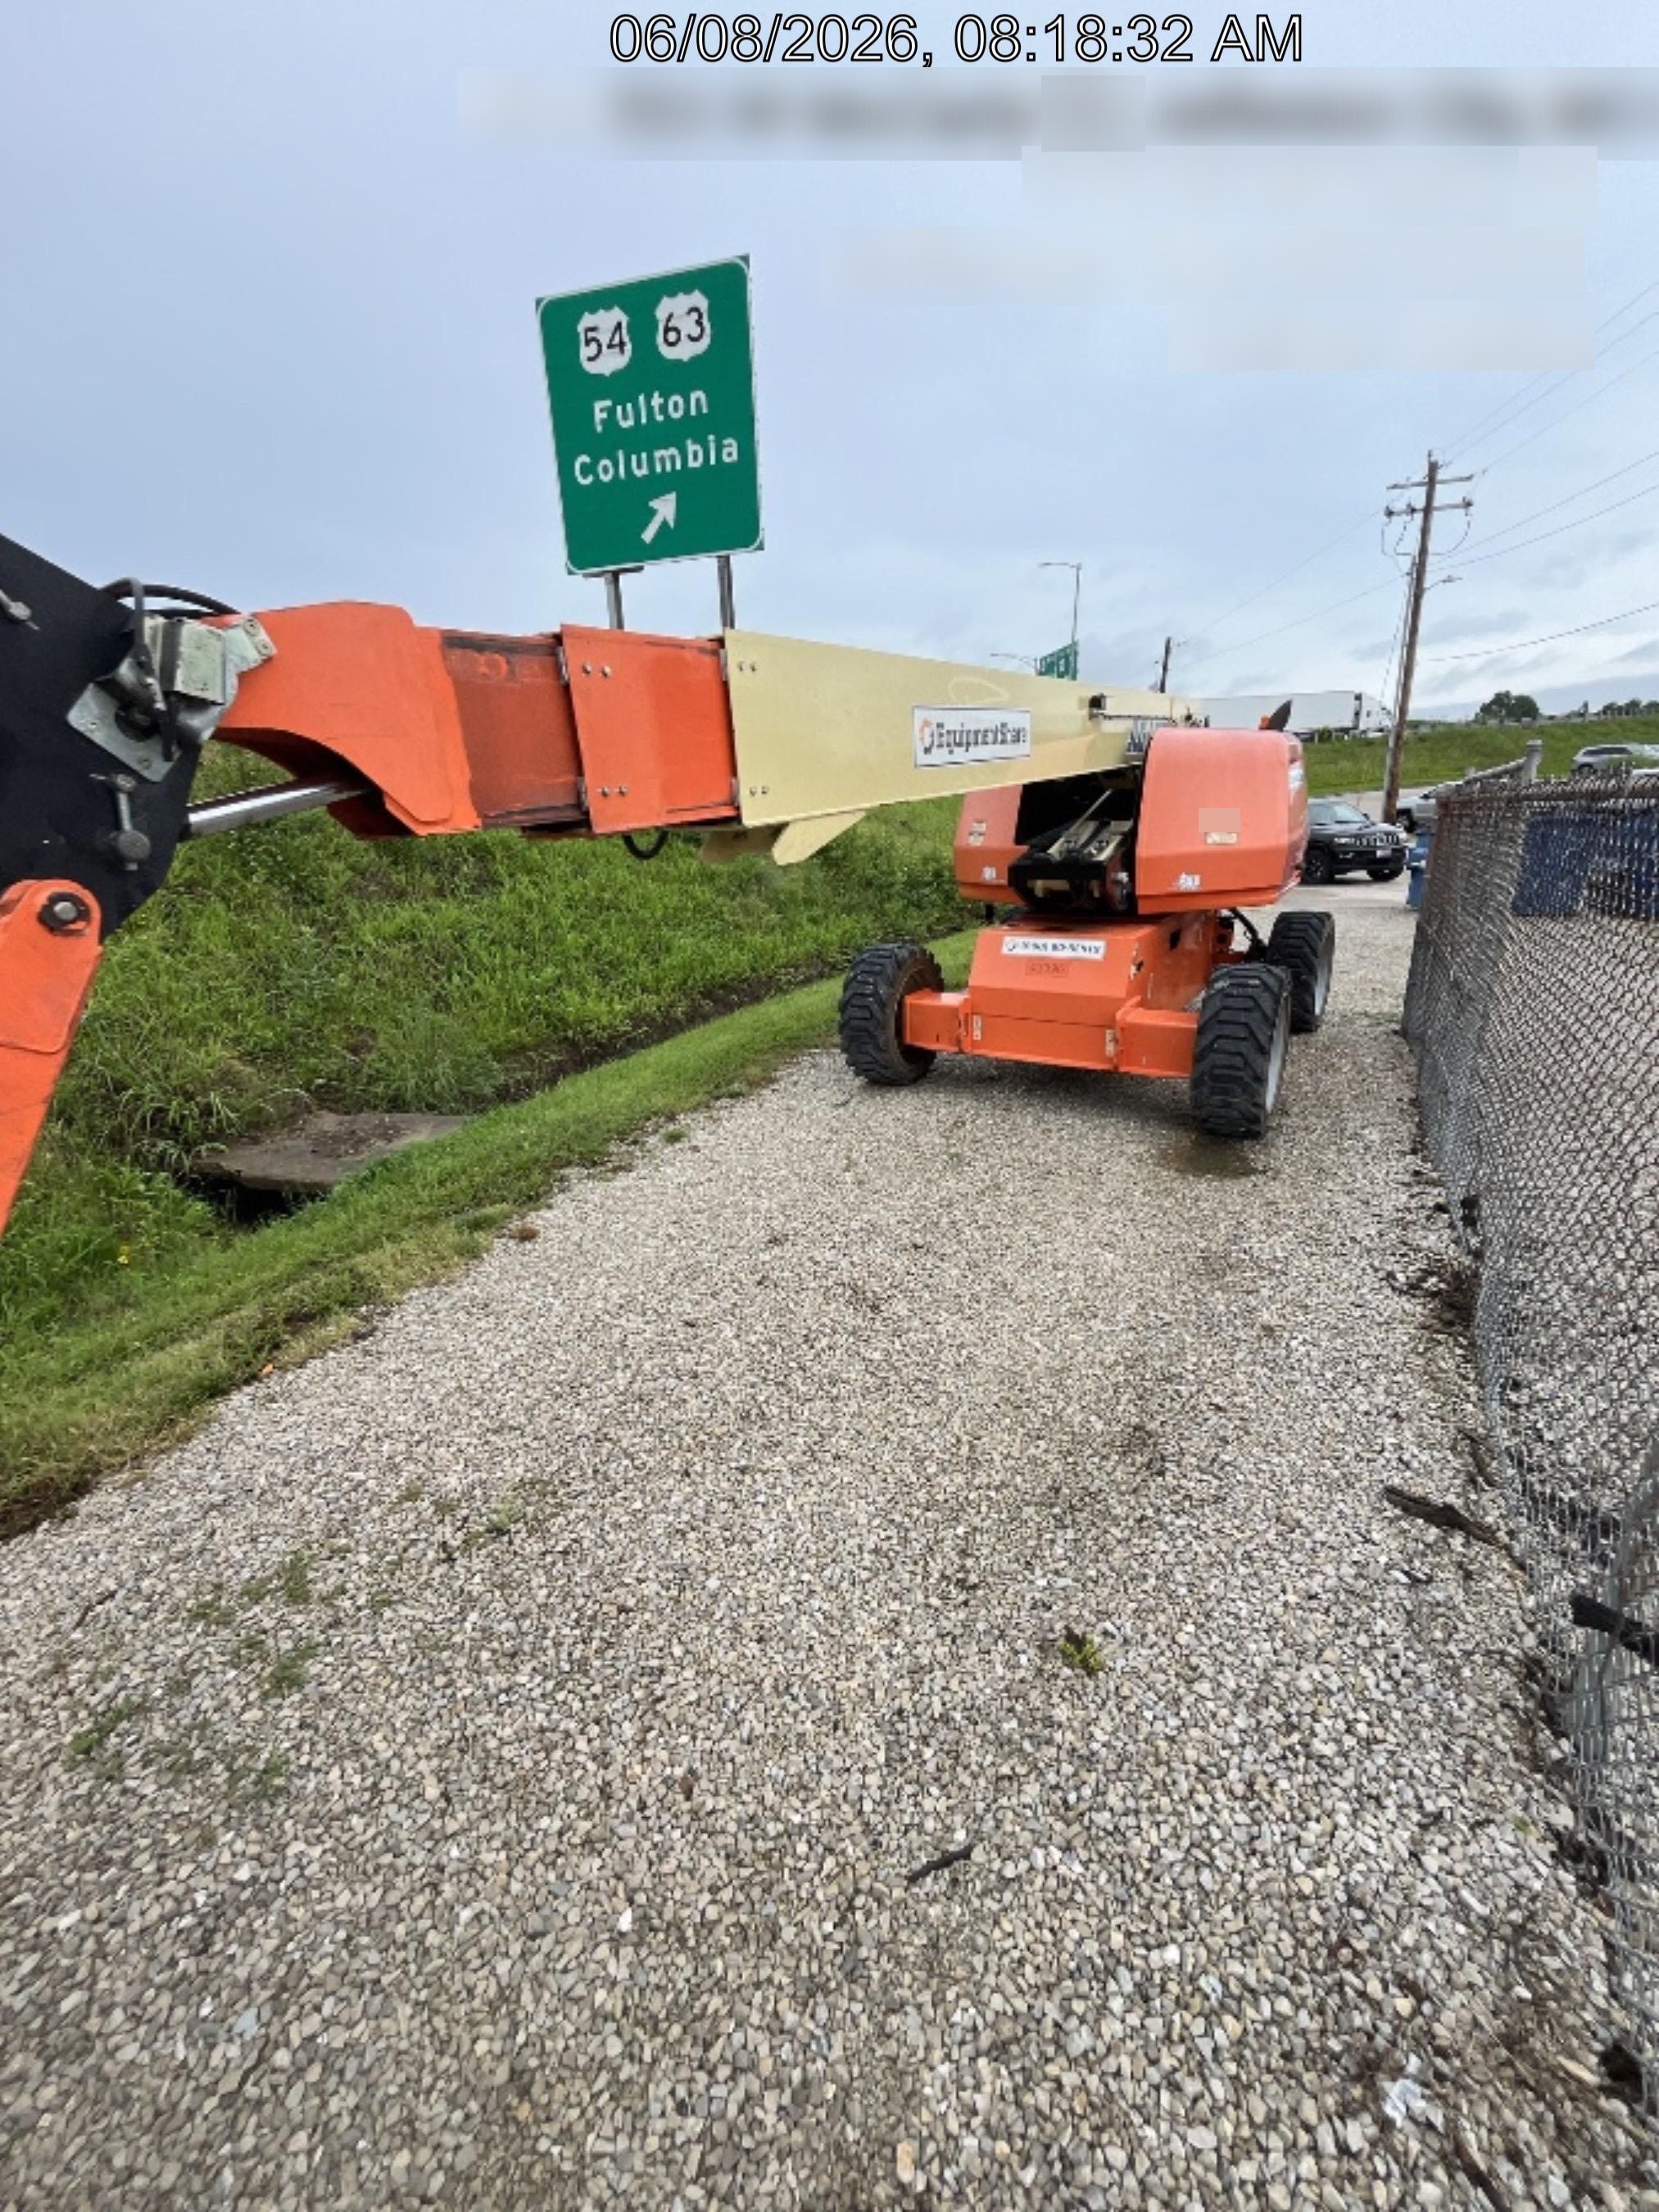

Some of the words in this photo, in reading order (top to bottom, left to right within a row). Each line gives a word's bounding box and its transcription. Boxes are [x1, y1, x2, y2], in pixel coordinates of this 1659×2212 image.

[583, 320, 627, 363] 54
[662, 306, 705, 347] 63
[592, 388, 709, 433] Fulton
[573, 433, 740, 487] Columbia
